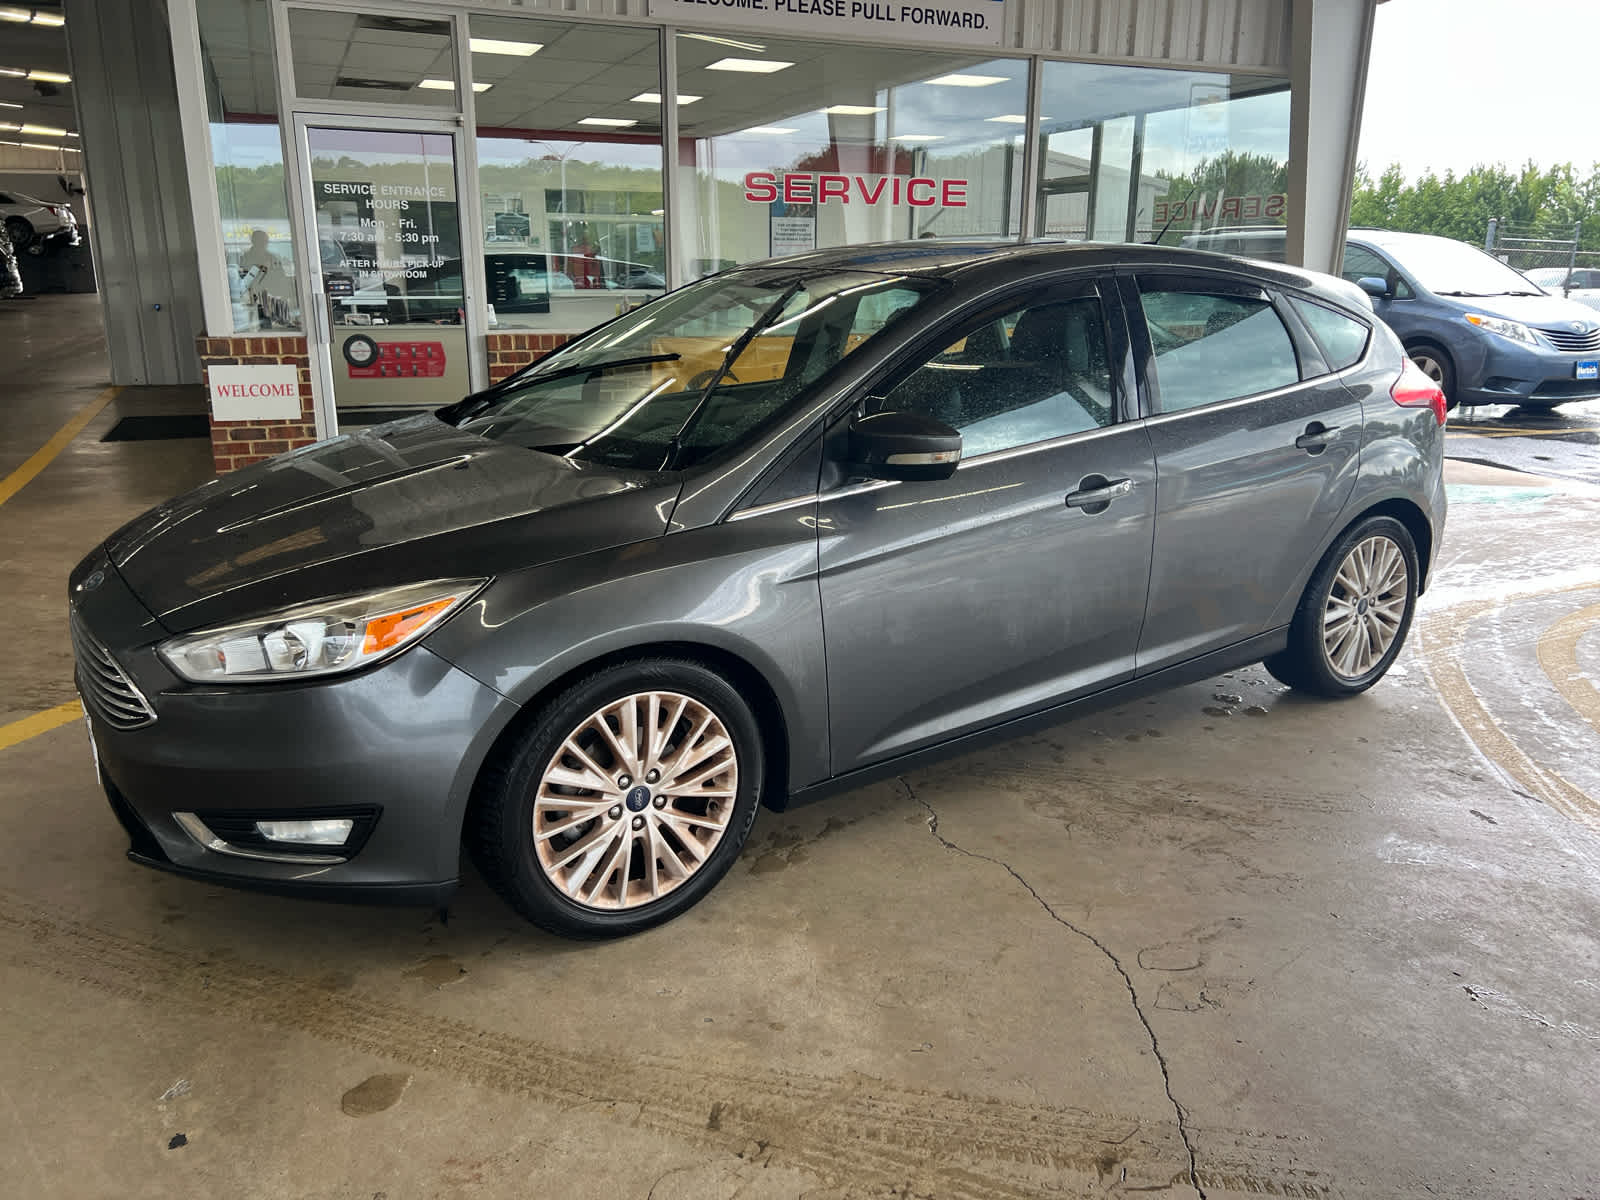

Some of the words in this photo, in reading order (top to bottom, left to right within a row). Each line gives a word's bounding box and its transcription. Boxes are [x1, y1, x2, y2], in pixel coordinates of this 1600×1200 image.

[775, 0, 846, 17] PLEASE
[851, 2, 896, 21] PULL
[901, 6, 989, 30] FORWARD.
[323, 183, 377, 195] SERVICE
[381, 185, 447, 197] ENTRANCE
[744, 172, 968, 208] SERVICE
[365, 199, 409, 210] HOURS
[360, 218, 389, 229] Mon.
[399, 219, 417, 229] Fri.
[340, 232, 365, 242] 7:30
[395, 232, 419, 242] 5:30
[422, 234, 440, 245] pm
[340, 259, 370, 268] AFTER
[372, 259, 407, 268] HURS
[408, 259, 444, 269] PICK-UP
[359, 270, 369, 279] IN
[216, 383, 296, 398] WELCOME
